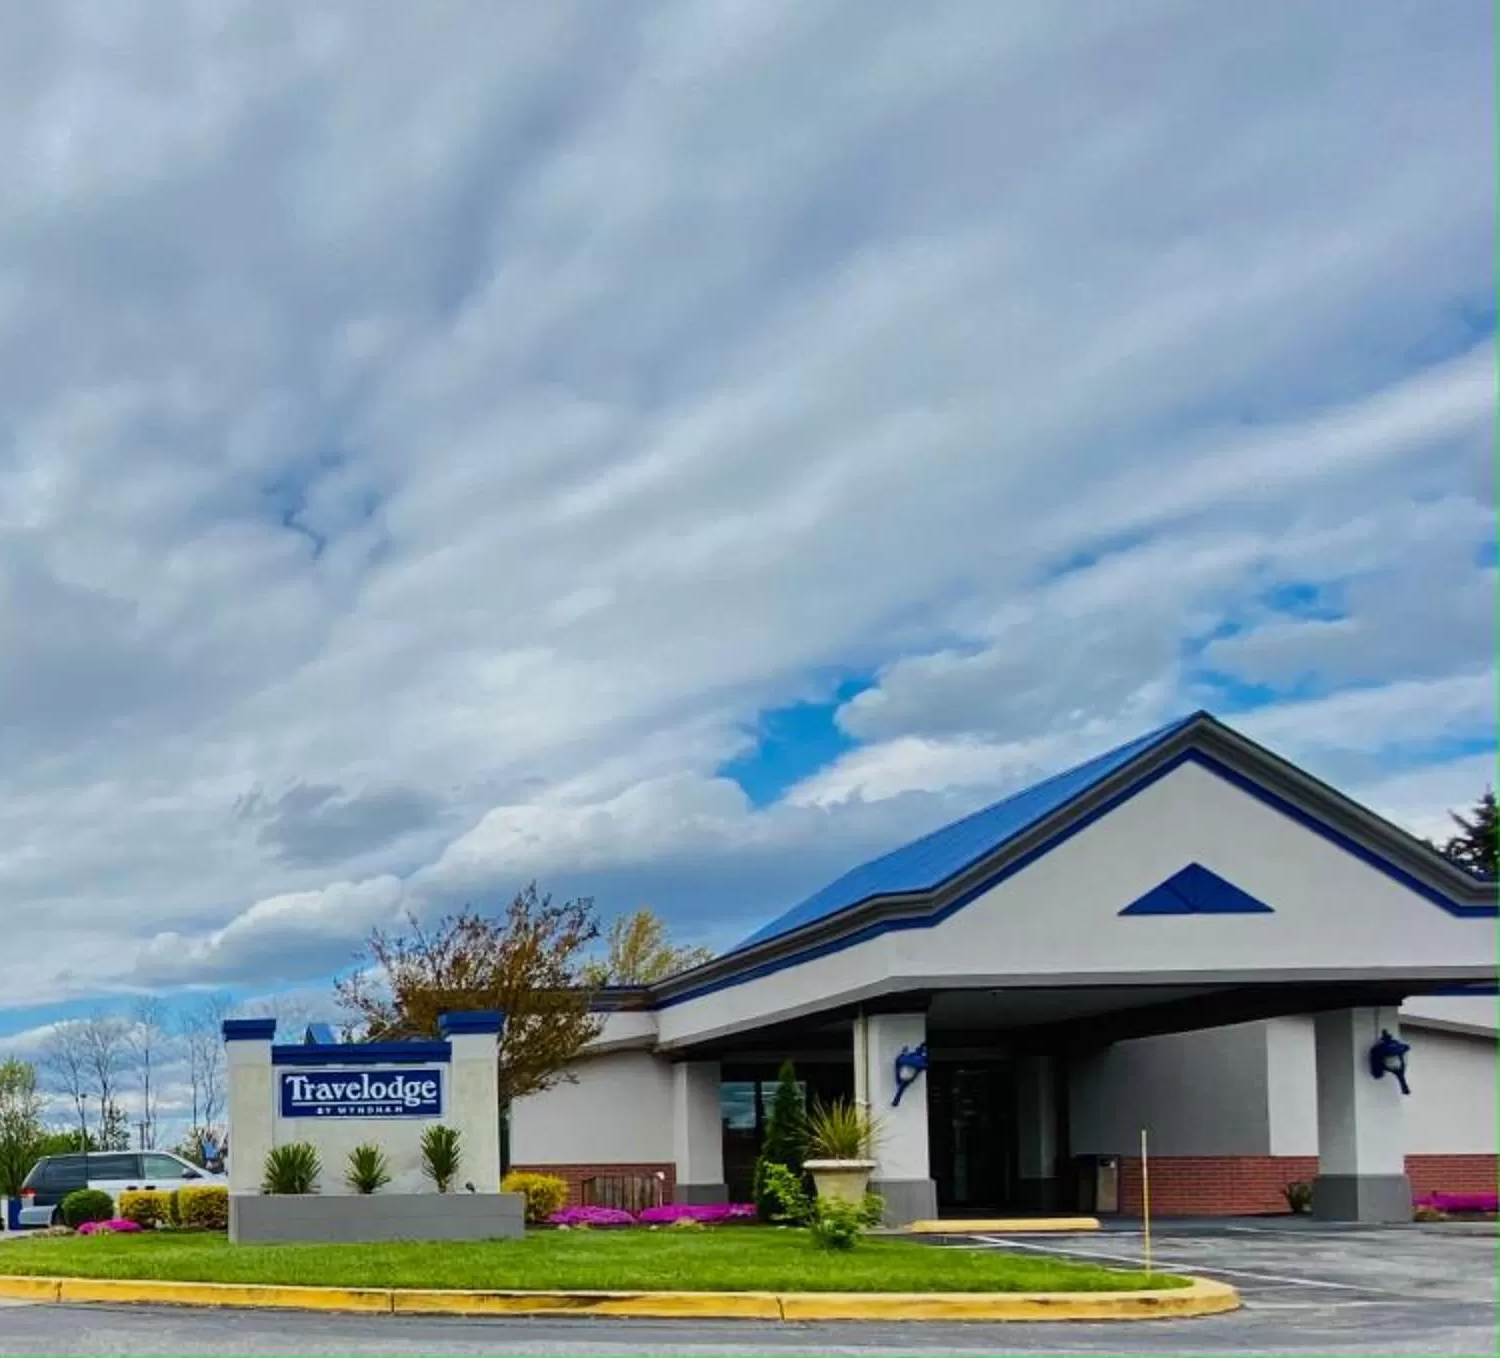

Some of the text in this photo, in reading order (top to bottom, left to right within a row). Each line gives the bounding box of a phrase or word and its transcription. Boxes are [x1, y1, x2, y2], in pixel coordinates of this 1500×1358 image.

[285, 1073, 437, 1107] Travelodge
[316, 1106, 403, 1115] BY WYNDHAM
